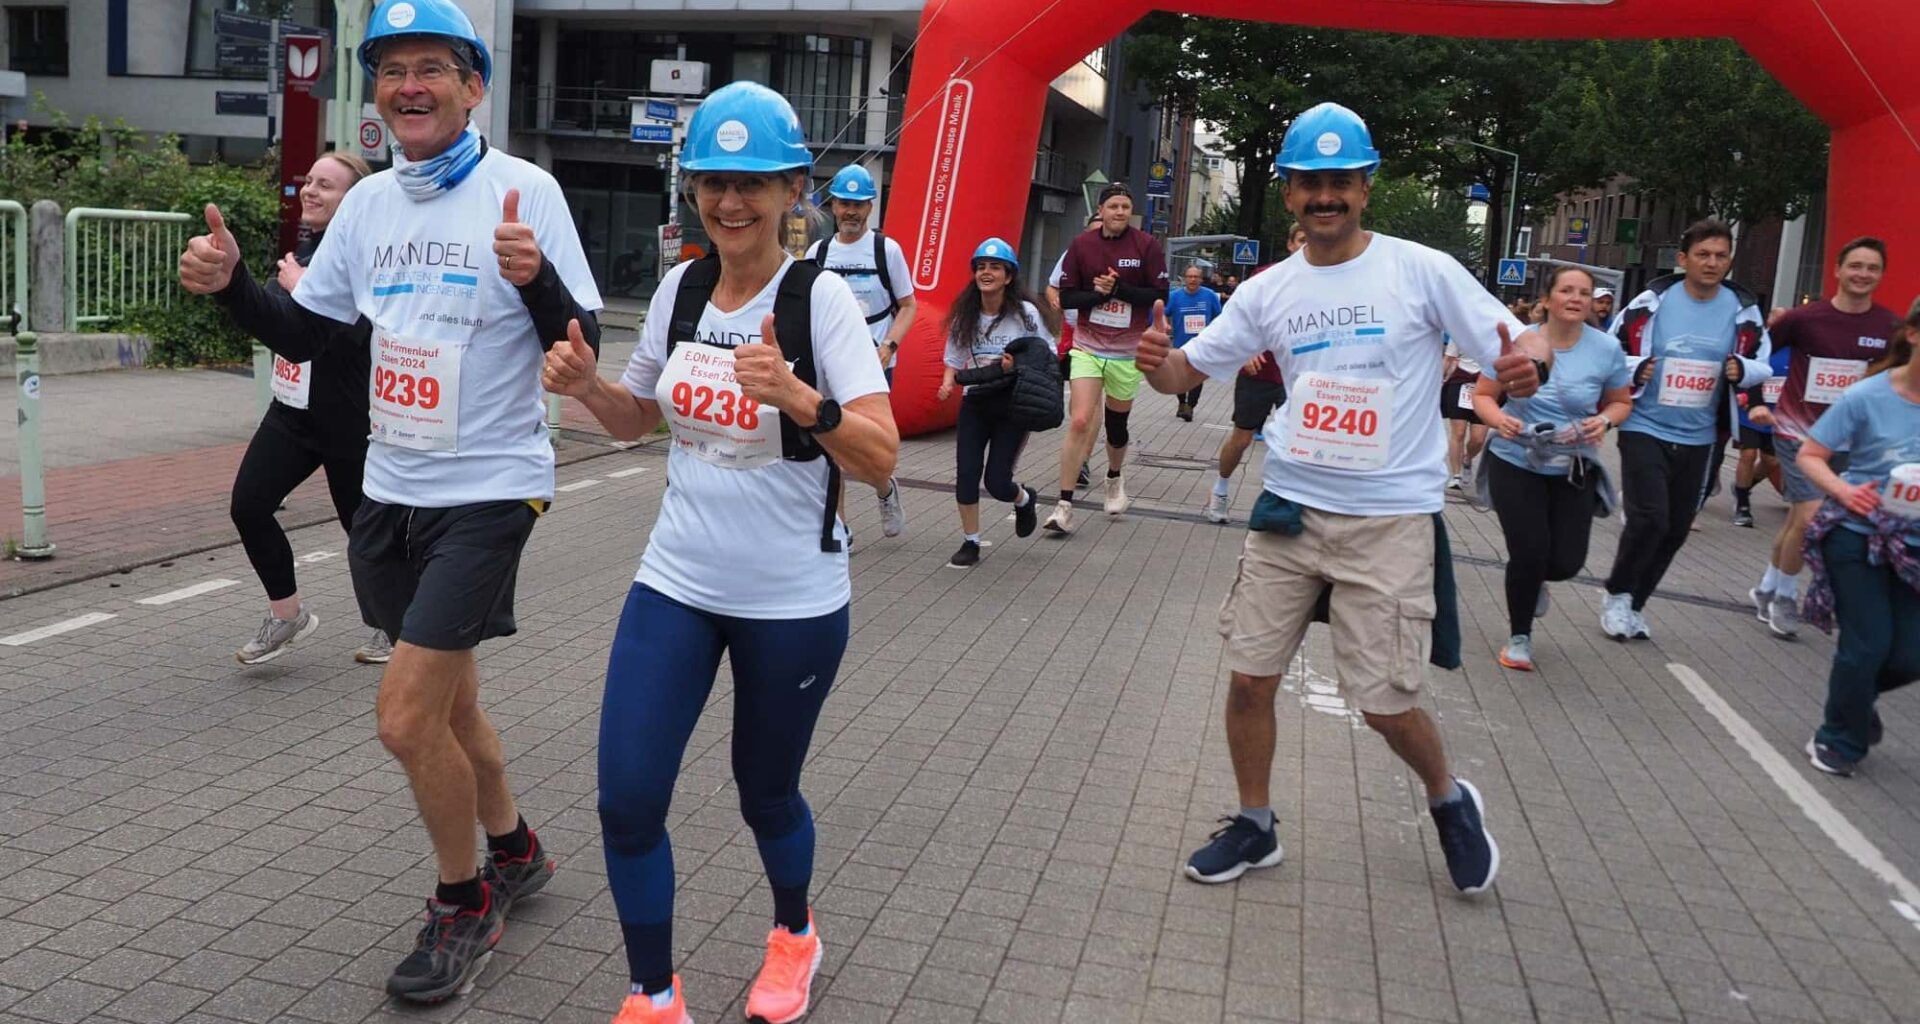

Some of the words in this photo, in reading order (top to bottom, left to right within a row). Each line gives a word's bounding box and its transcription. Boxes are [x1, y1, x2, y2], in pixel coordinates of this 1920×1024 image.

[948, 91, 964, 126] Musik.
[364, 128, 377, 142] 30
[943, 127, 957, 156] beste
[941, 156, 952, 173] die
[929, 228, 938, 246] von
[374, 241, 480, 270] MANDEL
[1288, 305, 1384, 335] MANDEL
[390, 341, 440, 358] Firmenlauf
[684, 350, 710, 365] E.ON
[400, 357, 426, 369] 2024
[691, 365, 720, 380] Essen
[375, 365, 440, 410] 9239
[1331, 382, 1379, 394] Firmenlauf
[1665, 374, 1716, 391] 10482
[1317, 390, 1341, 400] Essen
[1344, 394, 1368, 404] 2024
[672, 381, 760, 431] 9238
[1302, 402, 1378, 437] 9240
